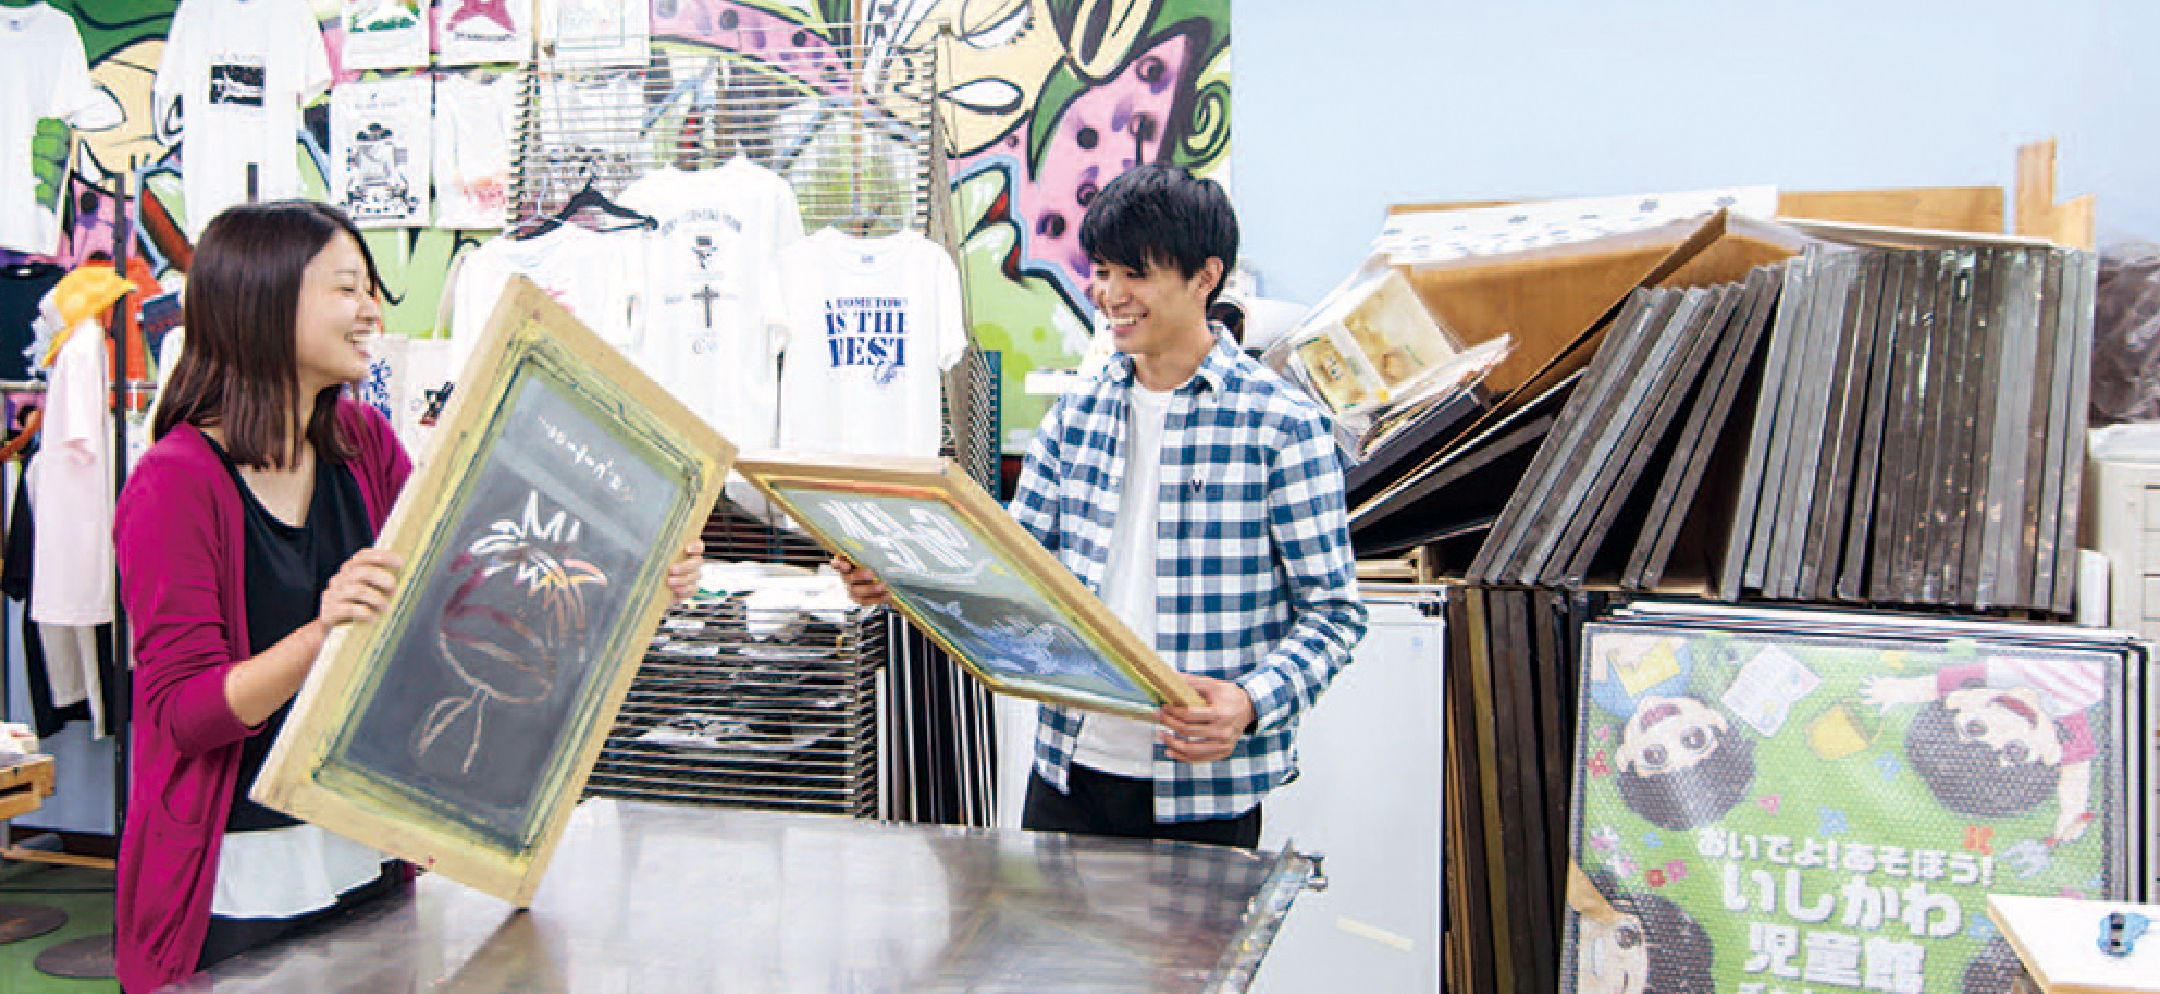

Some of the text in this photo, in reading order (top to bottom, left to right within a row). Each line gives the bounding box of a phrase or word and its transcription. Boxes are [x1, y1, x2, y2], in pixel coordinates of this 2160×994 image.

[1723, 861, 1963, 938] いしかわ
[1744, 921, 1926, 994] 児童館
